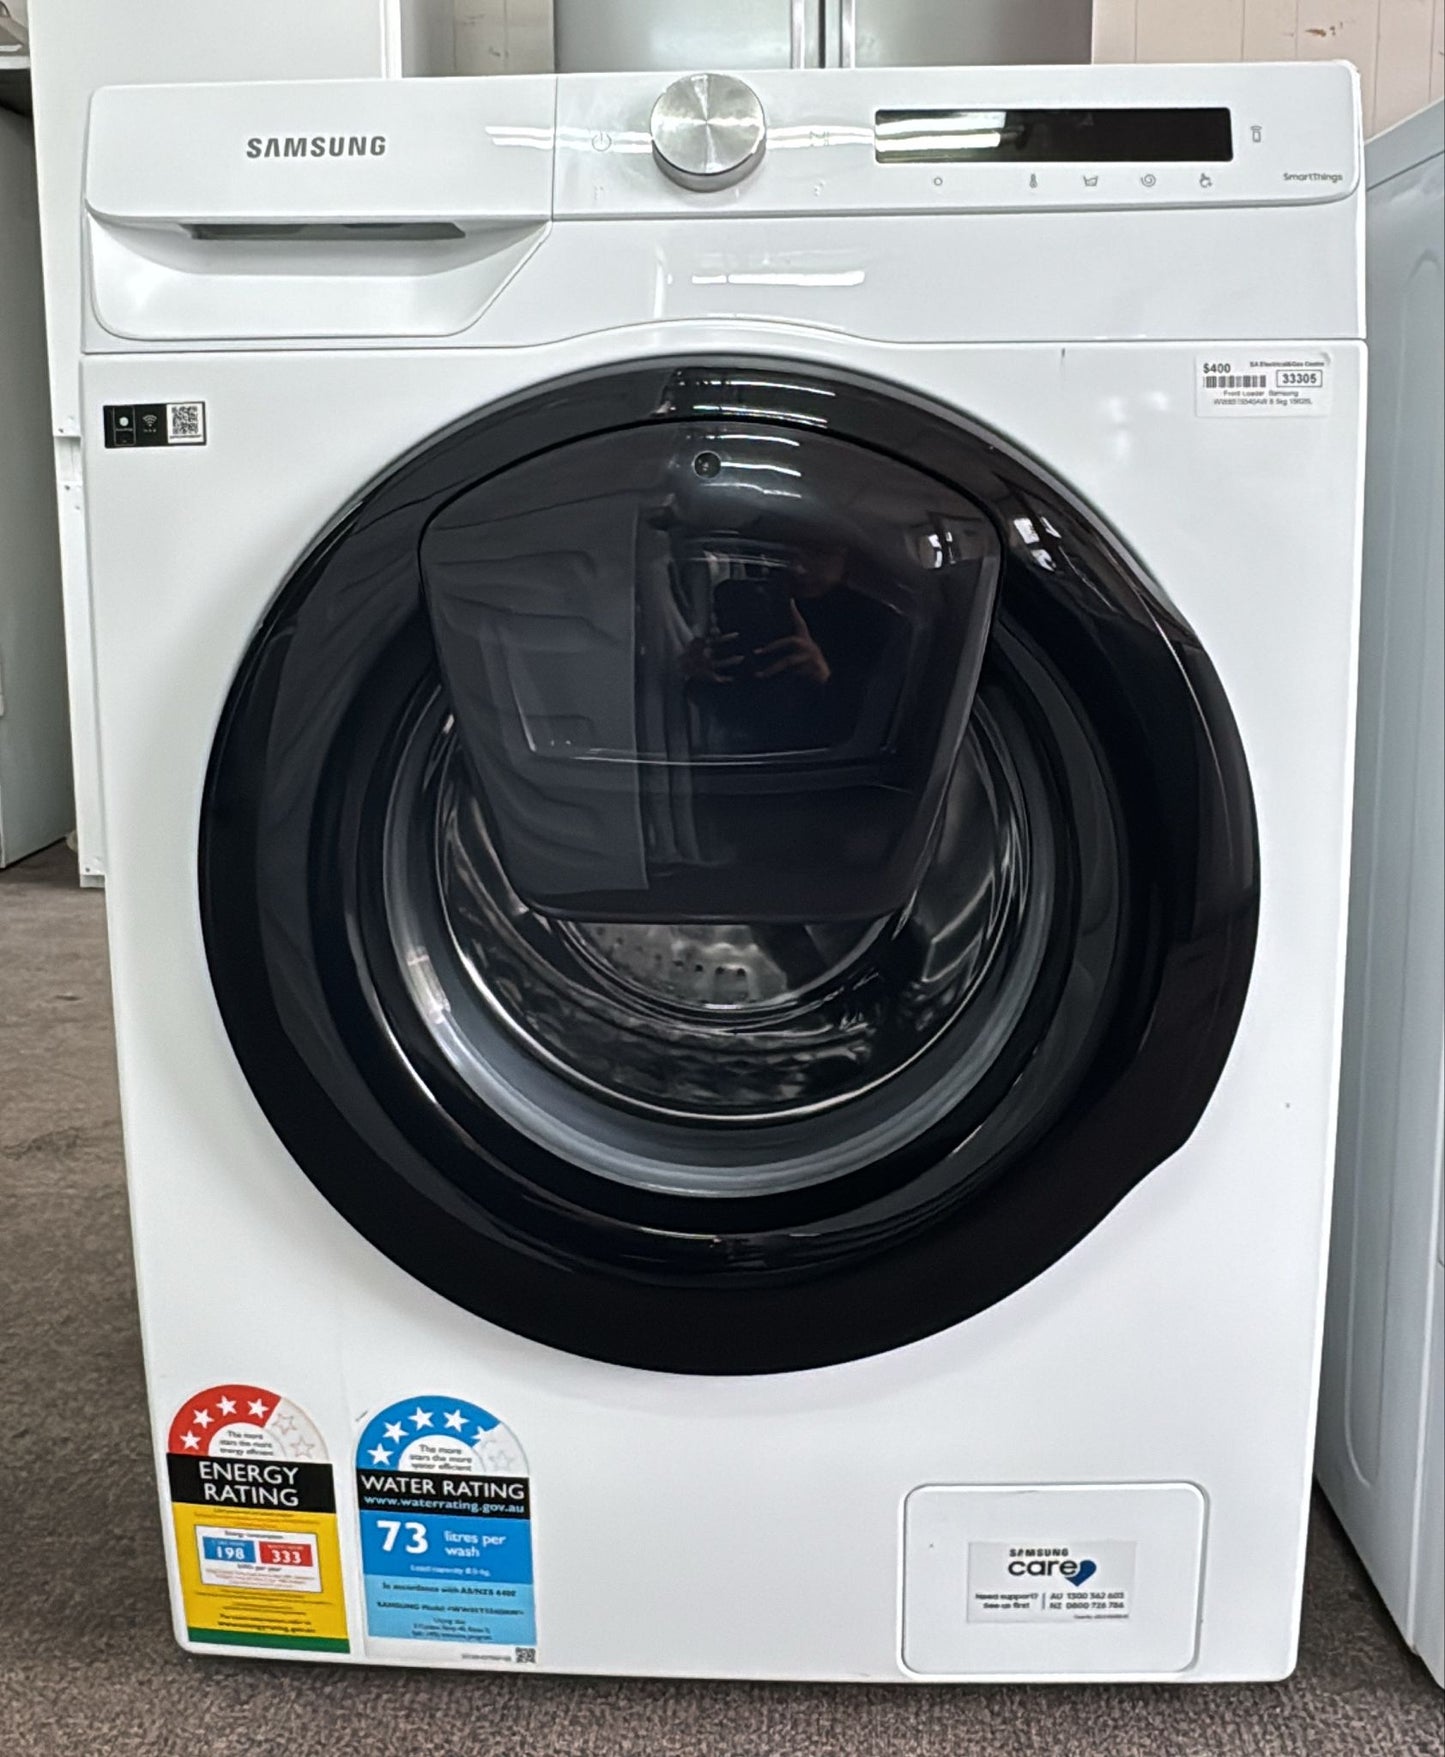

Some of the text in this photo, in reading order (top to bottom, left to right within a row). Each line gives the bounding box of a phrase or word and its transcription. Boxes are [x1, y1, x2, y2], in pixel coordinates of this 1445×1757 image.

[246, 136, 386, 158] SAMSUNG
[1283, 172, 1343, 184] SmartThings
[1203, 363, 1231, 374] $400
[1282, 373, 1317, 384] 33305
[419, 1444, 463, 1455] The more
[409, 1453, 472, 1464] stars the more
[199, 1461, 299, 1485] ENERGY
[203, 1483, 299, 1507] RATING
[360, 1474, 525, 1500] WATER RATING
[363, 1495, 525, 1514] www.waterrating.gov.au
[376, 1519, 429, 1554] 73
[443, 1530, 507, 1548] litres per
[216, 1546, 302, 1564] 198 333
[444, 1545, 481, 1558] wash
[1009, 1548, 1069, 1557] SAMSUNG
[1008, 1560, 1078, 1577] care
